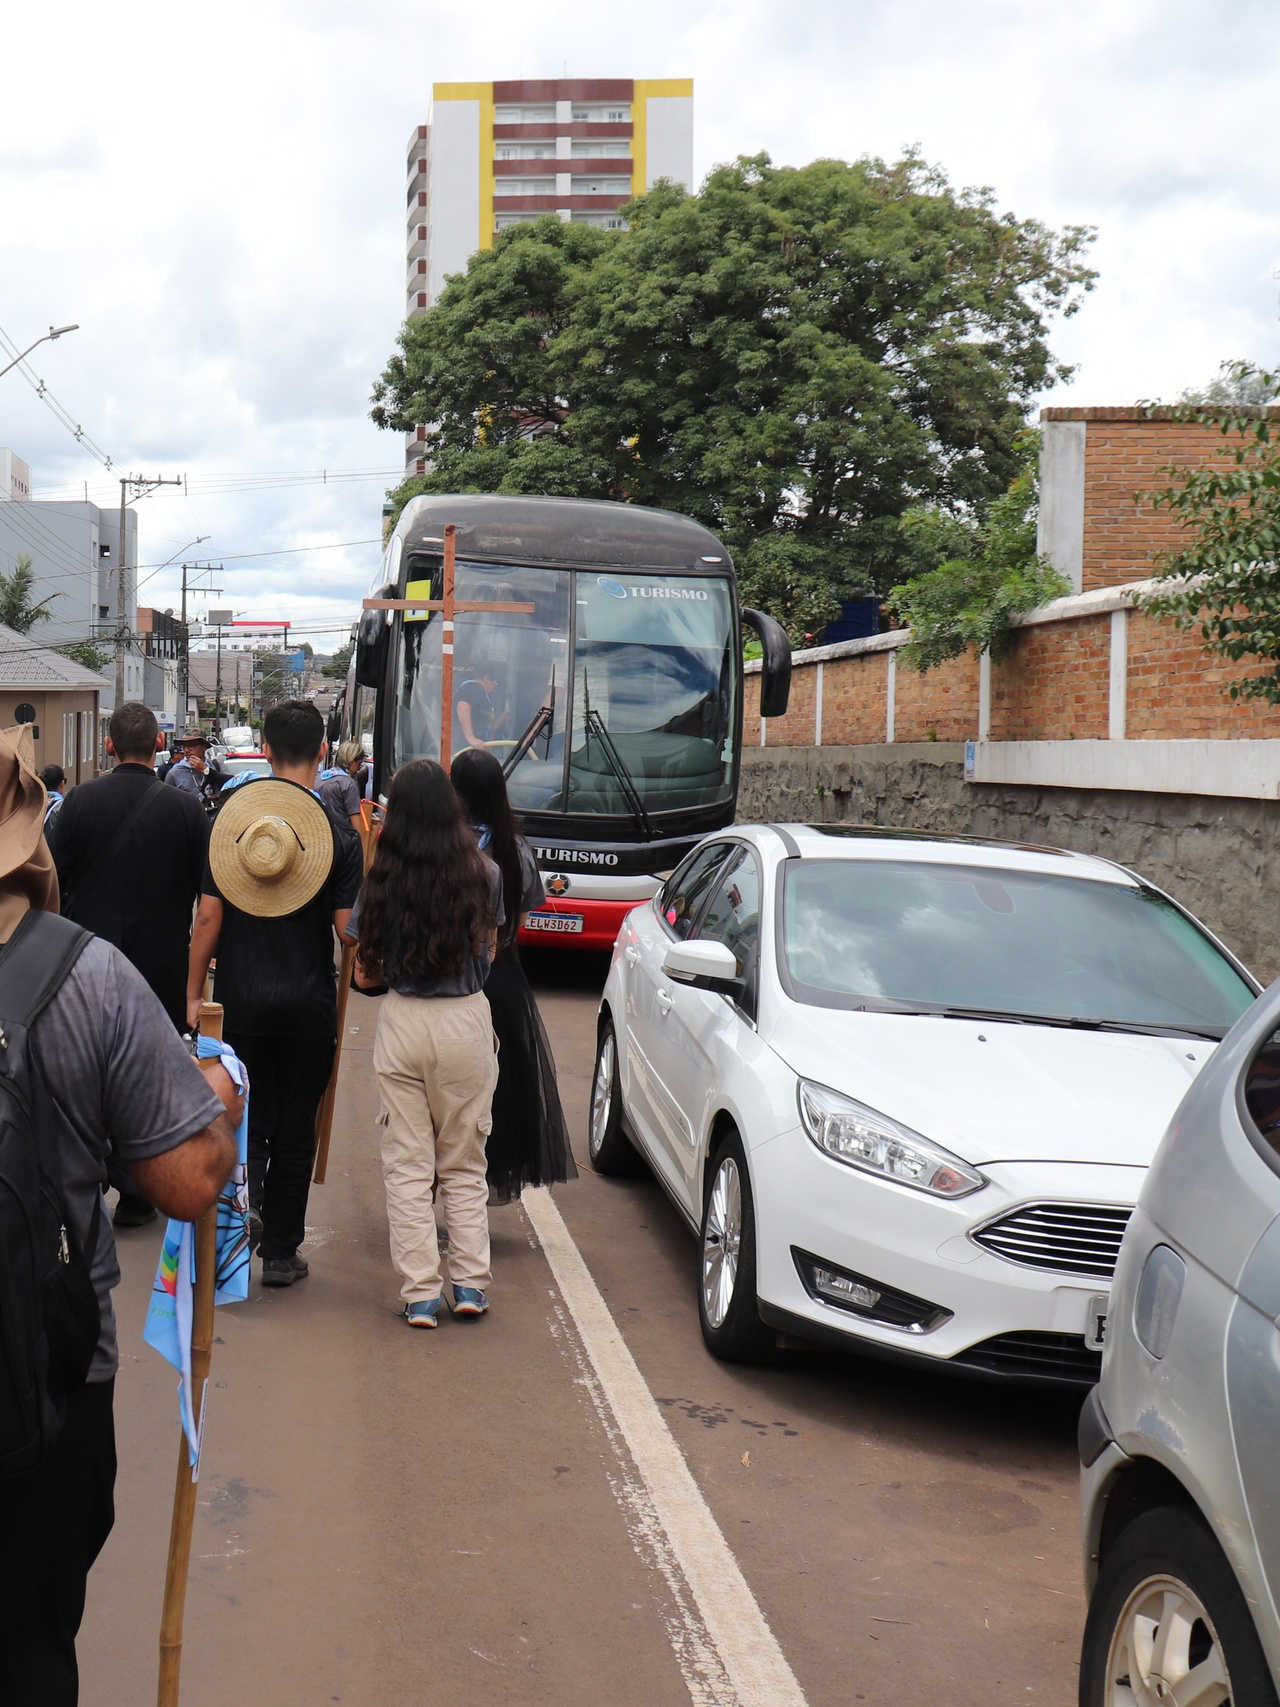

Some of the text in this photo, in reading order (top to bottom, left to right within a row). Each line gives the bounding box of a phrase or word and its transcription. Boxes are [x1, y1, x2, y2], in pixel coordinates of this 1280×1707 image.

[629, 587, 708, 600] TURISMO
[534, 847, 619, 866] TURISMO
[530, 918, 577, 931] ELW3D62
